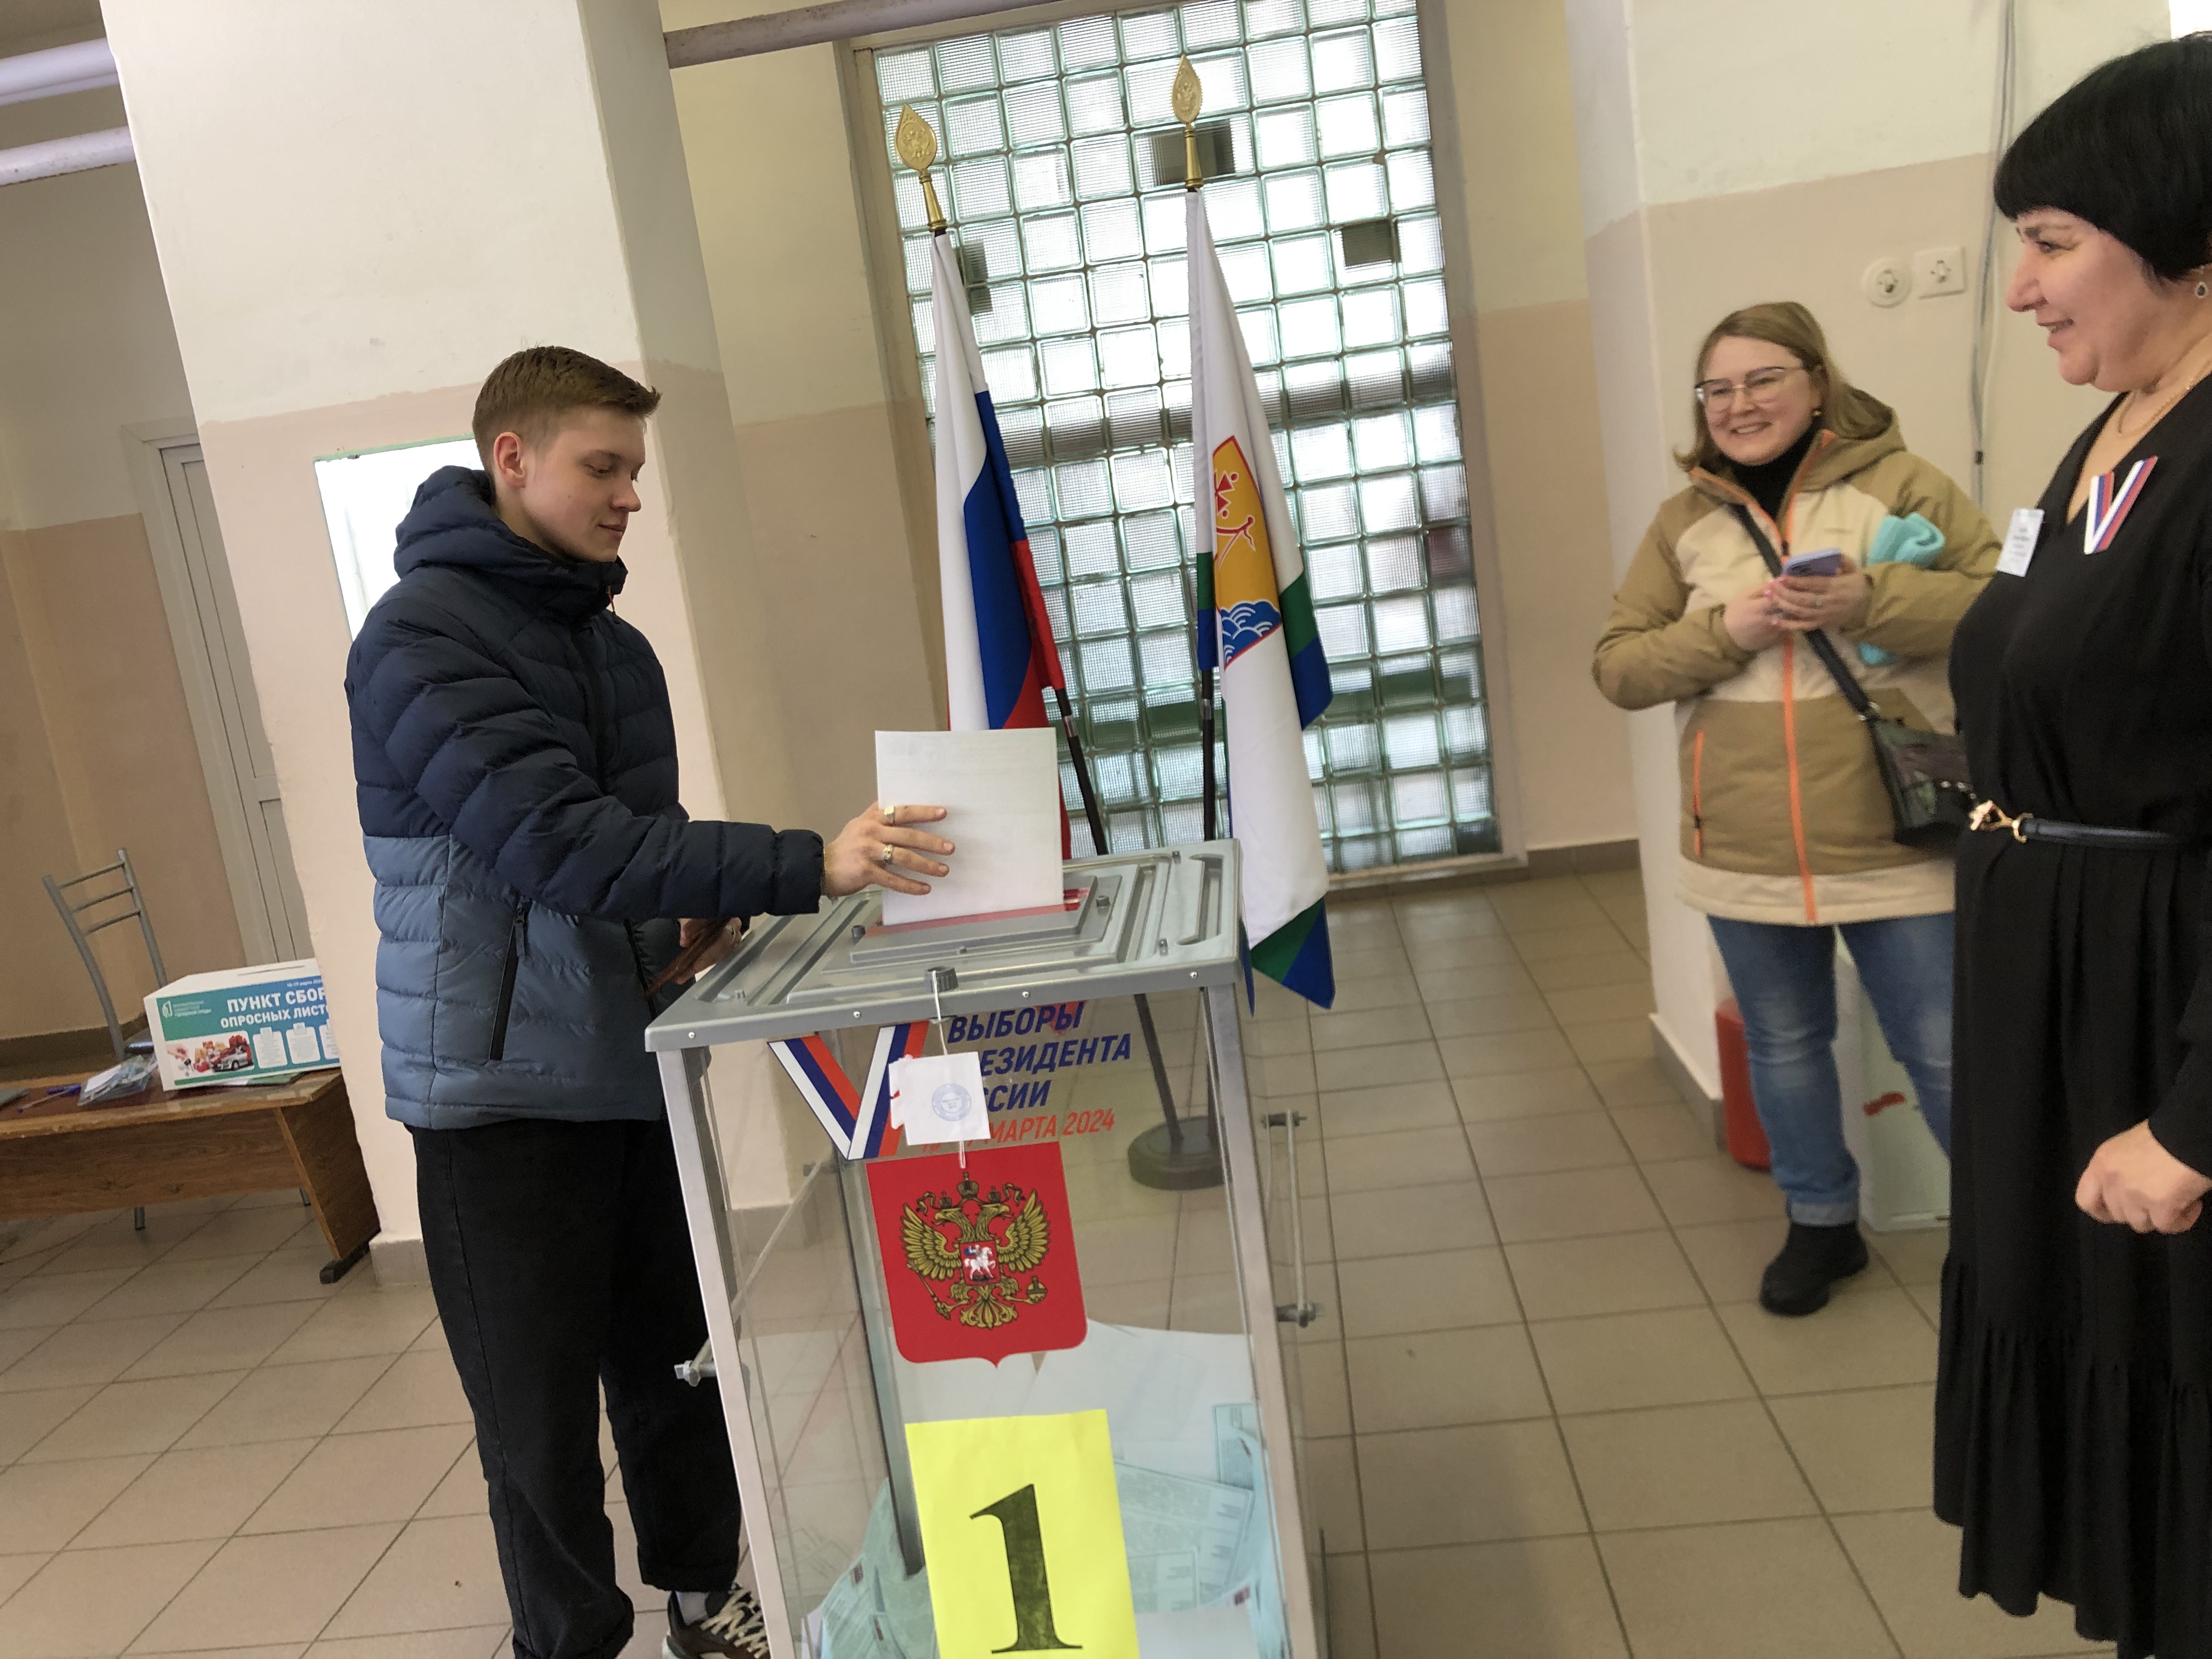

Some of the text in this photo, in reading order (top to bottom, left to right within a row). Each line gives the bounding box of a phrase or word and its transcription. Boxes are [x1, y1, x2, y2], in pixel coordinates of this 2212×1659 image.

[221, 1009, 291, 1028] ОПРОСНЫХ
[227, 992, 281, 1013] ПУНКТ
[947, 1000, 1086, 1043] ВЫБОРЫ
[981, 1033, 1131, 1077] ЕЗИДЕНТА
[984, 1080, 1052, 1113] СИИ
[984, 1108, 1115, 1145] МАРТА 2024
[969, 1483, 1083, 1654] 1
